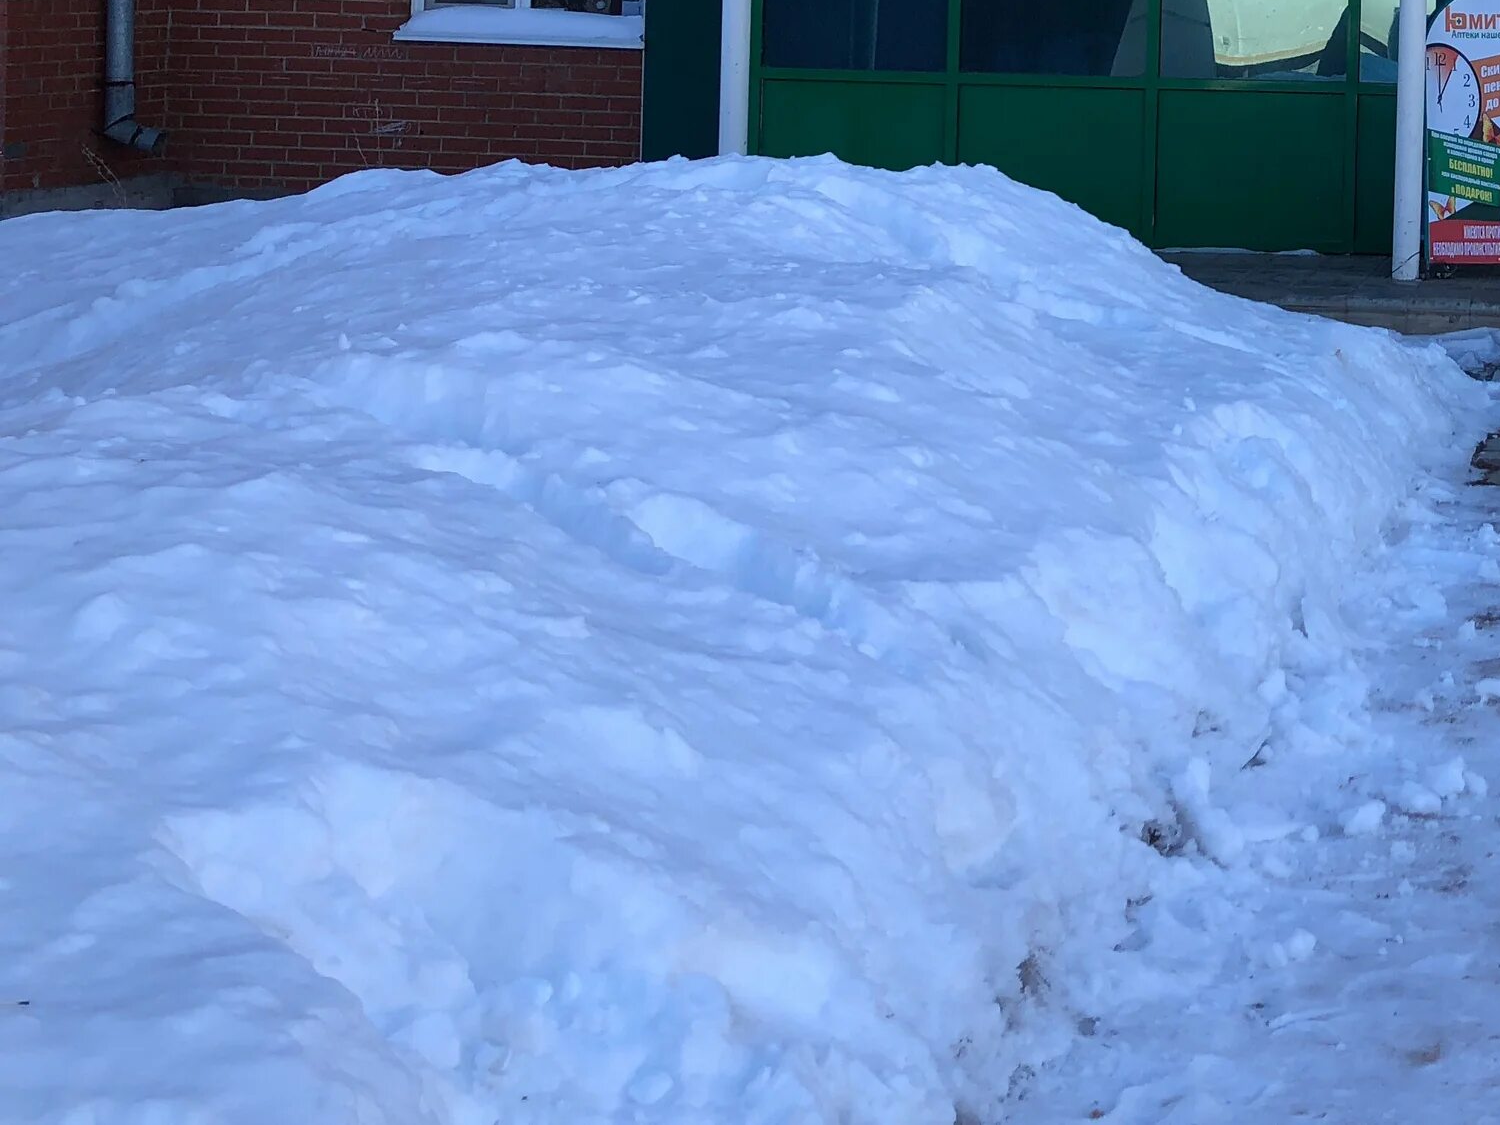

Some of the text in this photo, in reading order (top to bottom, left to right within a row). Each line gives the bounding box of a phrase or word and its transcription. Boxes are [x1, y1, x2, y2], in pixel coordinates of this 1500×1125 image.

[1451, 30, 1481, 39] Аптеки
[1434, 52, 1446, 66] 12
[1463, 74, 1471, 87] 2
[1468, 94, 1476, 107] 3
[1485, 98, 1499, 112] до
[1464, 115, 1471, 128] 4
[1448, 158, 1494, 179] БЕСПЛАТНО!
[1455, 184, 1493, 203] ПОДАРОК!
